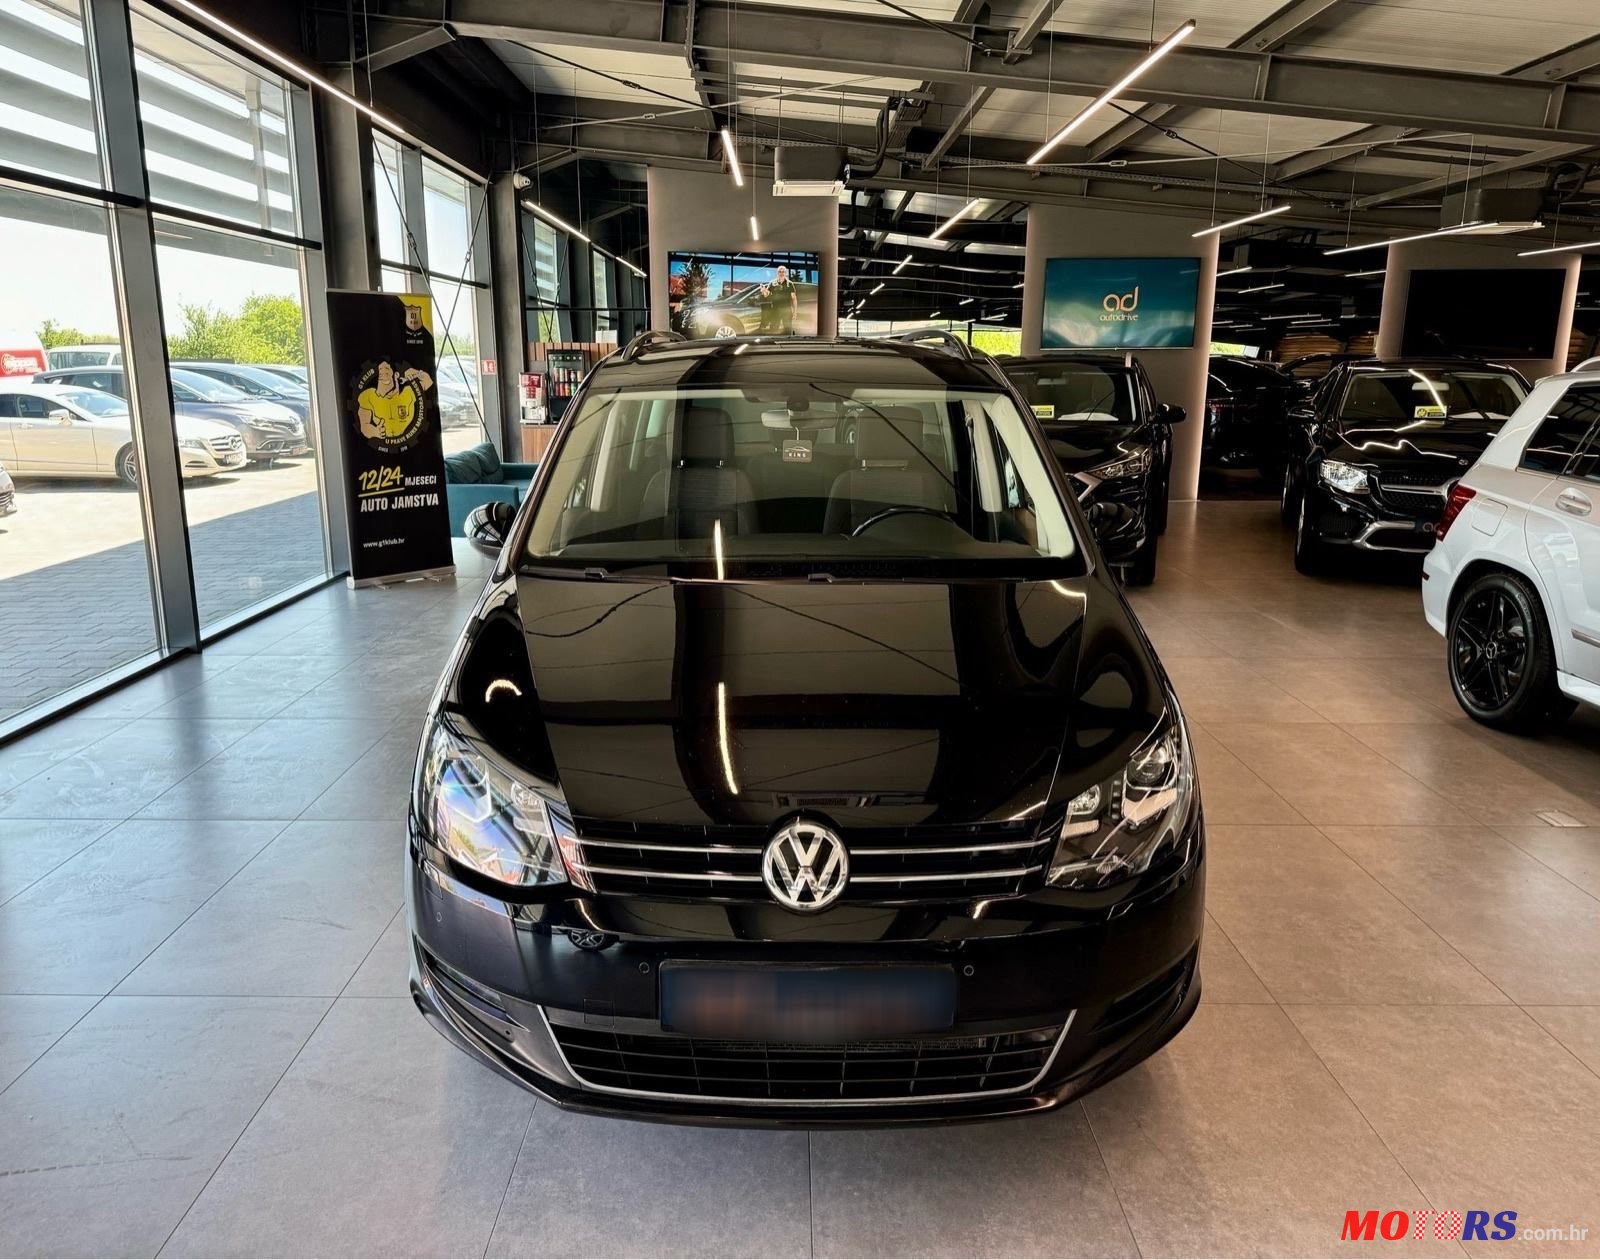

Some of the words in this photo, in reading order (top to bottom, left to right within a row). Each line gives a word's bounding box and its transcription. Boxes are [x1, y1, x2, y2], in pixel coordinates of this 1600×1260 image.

[1099, 313, 1139, 321] autodrive
[359, 465, 404, 491] 12/24
[405, 475, 437, 486] MJESECI
[360, 497, 388, 512] AUTO
[391, 493, 439, 510] JAMSTVA
[363, 538, 405, 548] www.g1klub.hr
